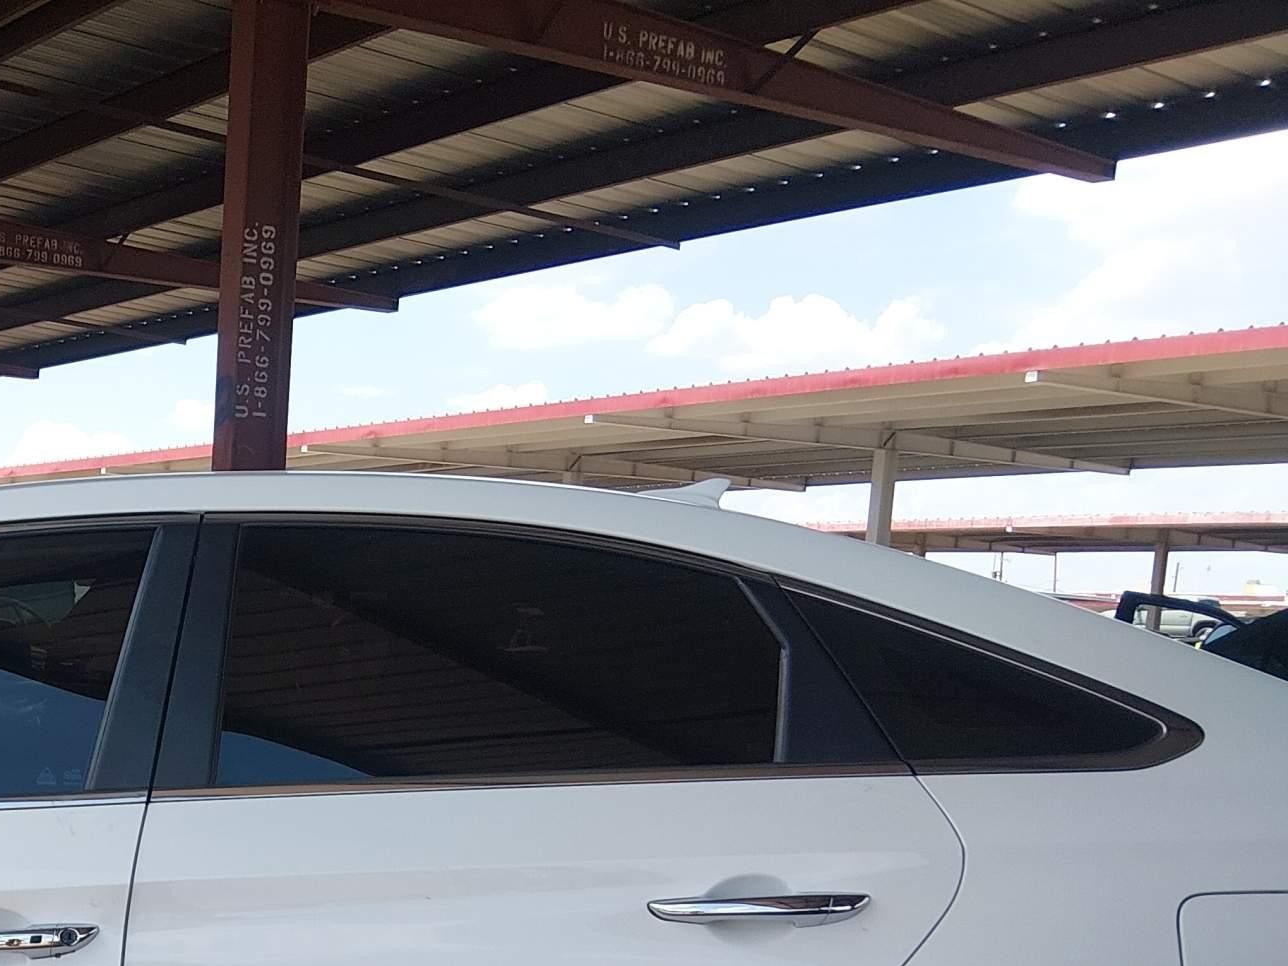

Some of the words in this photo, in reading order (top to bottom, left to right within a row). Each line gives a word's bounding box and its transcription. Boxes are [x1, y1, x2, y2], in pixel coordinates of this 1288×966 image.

[603, 43, 726, 85] 1-866-799-0969
[639, 30, 696, 60] PREFAB
[701, 48, 727, 69] INC.
[15, 233, 59, 251] PREFAB
[243, 221, 259, 263] INC.
[237, 276, 256, 364] PREFAB
[251, 224, 277, 418] 1-866-799-0969
[235, 376, 252, 419] U.S.
